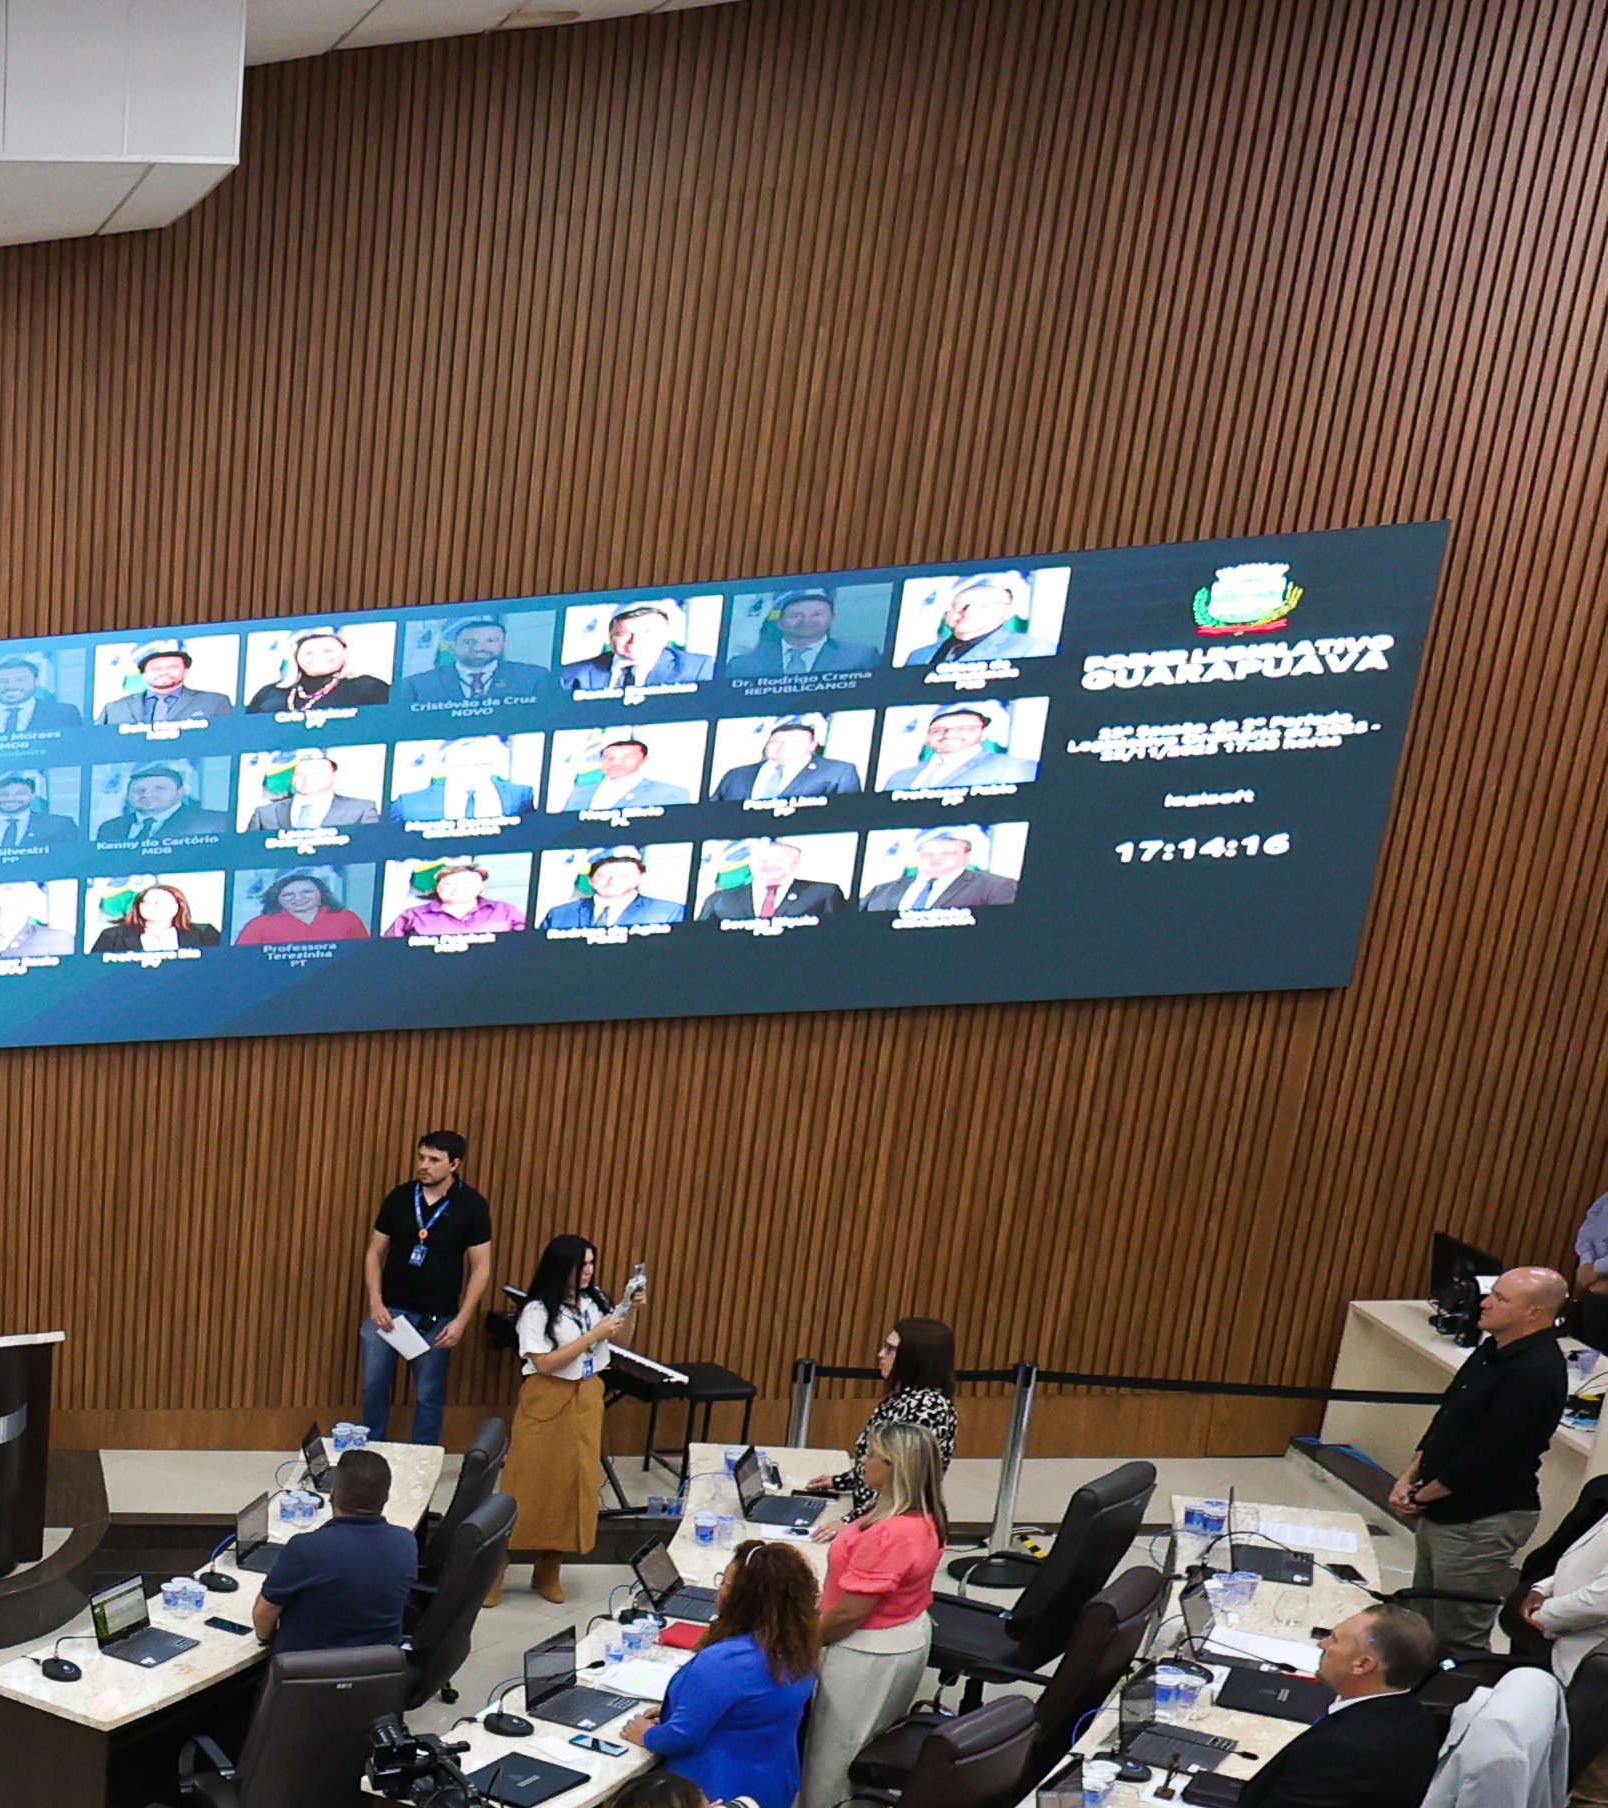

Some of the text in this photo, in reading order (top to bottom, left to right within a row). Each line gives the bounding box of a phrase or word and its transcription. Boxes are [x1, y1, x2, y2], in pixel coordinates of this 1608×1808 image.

[1084, 635, 1394, 672] PODER LEGISLATIVO
[1082, 651, 1388, 690] GUARAPUAVA
[731, 671, 873, 689] Dr. Rodrigo Crema
[744, 681, 858, 696] REPUBLICANOS
[410, 696, 537, 713] Cristóvão da Cruz
[451, 707, 494, 718] NOVO
[11, 730, 61, 742] Moraes
[0, 741, 29, 750] MDB
[97, 835, 218, 852] Kenny do Cartório
[1116, 833, 1290, 862] 17:14:16
[142, 847, 173, 856] MDB
[263, 942, 337, 954] Professora
[266, 950, 333, 962] Terezinha
[290, 959, 307, 967] PT
